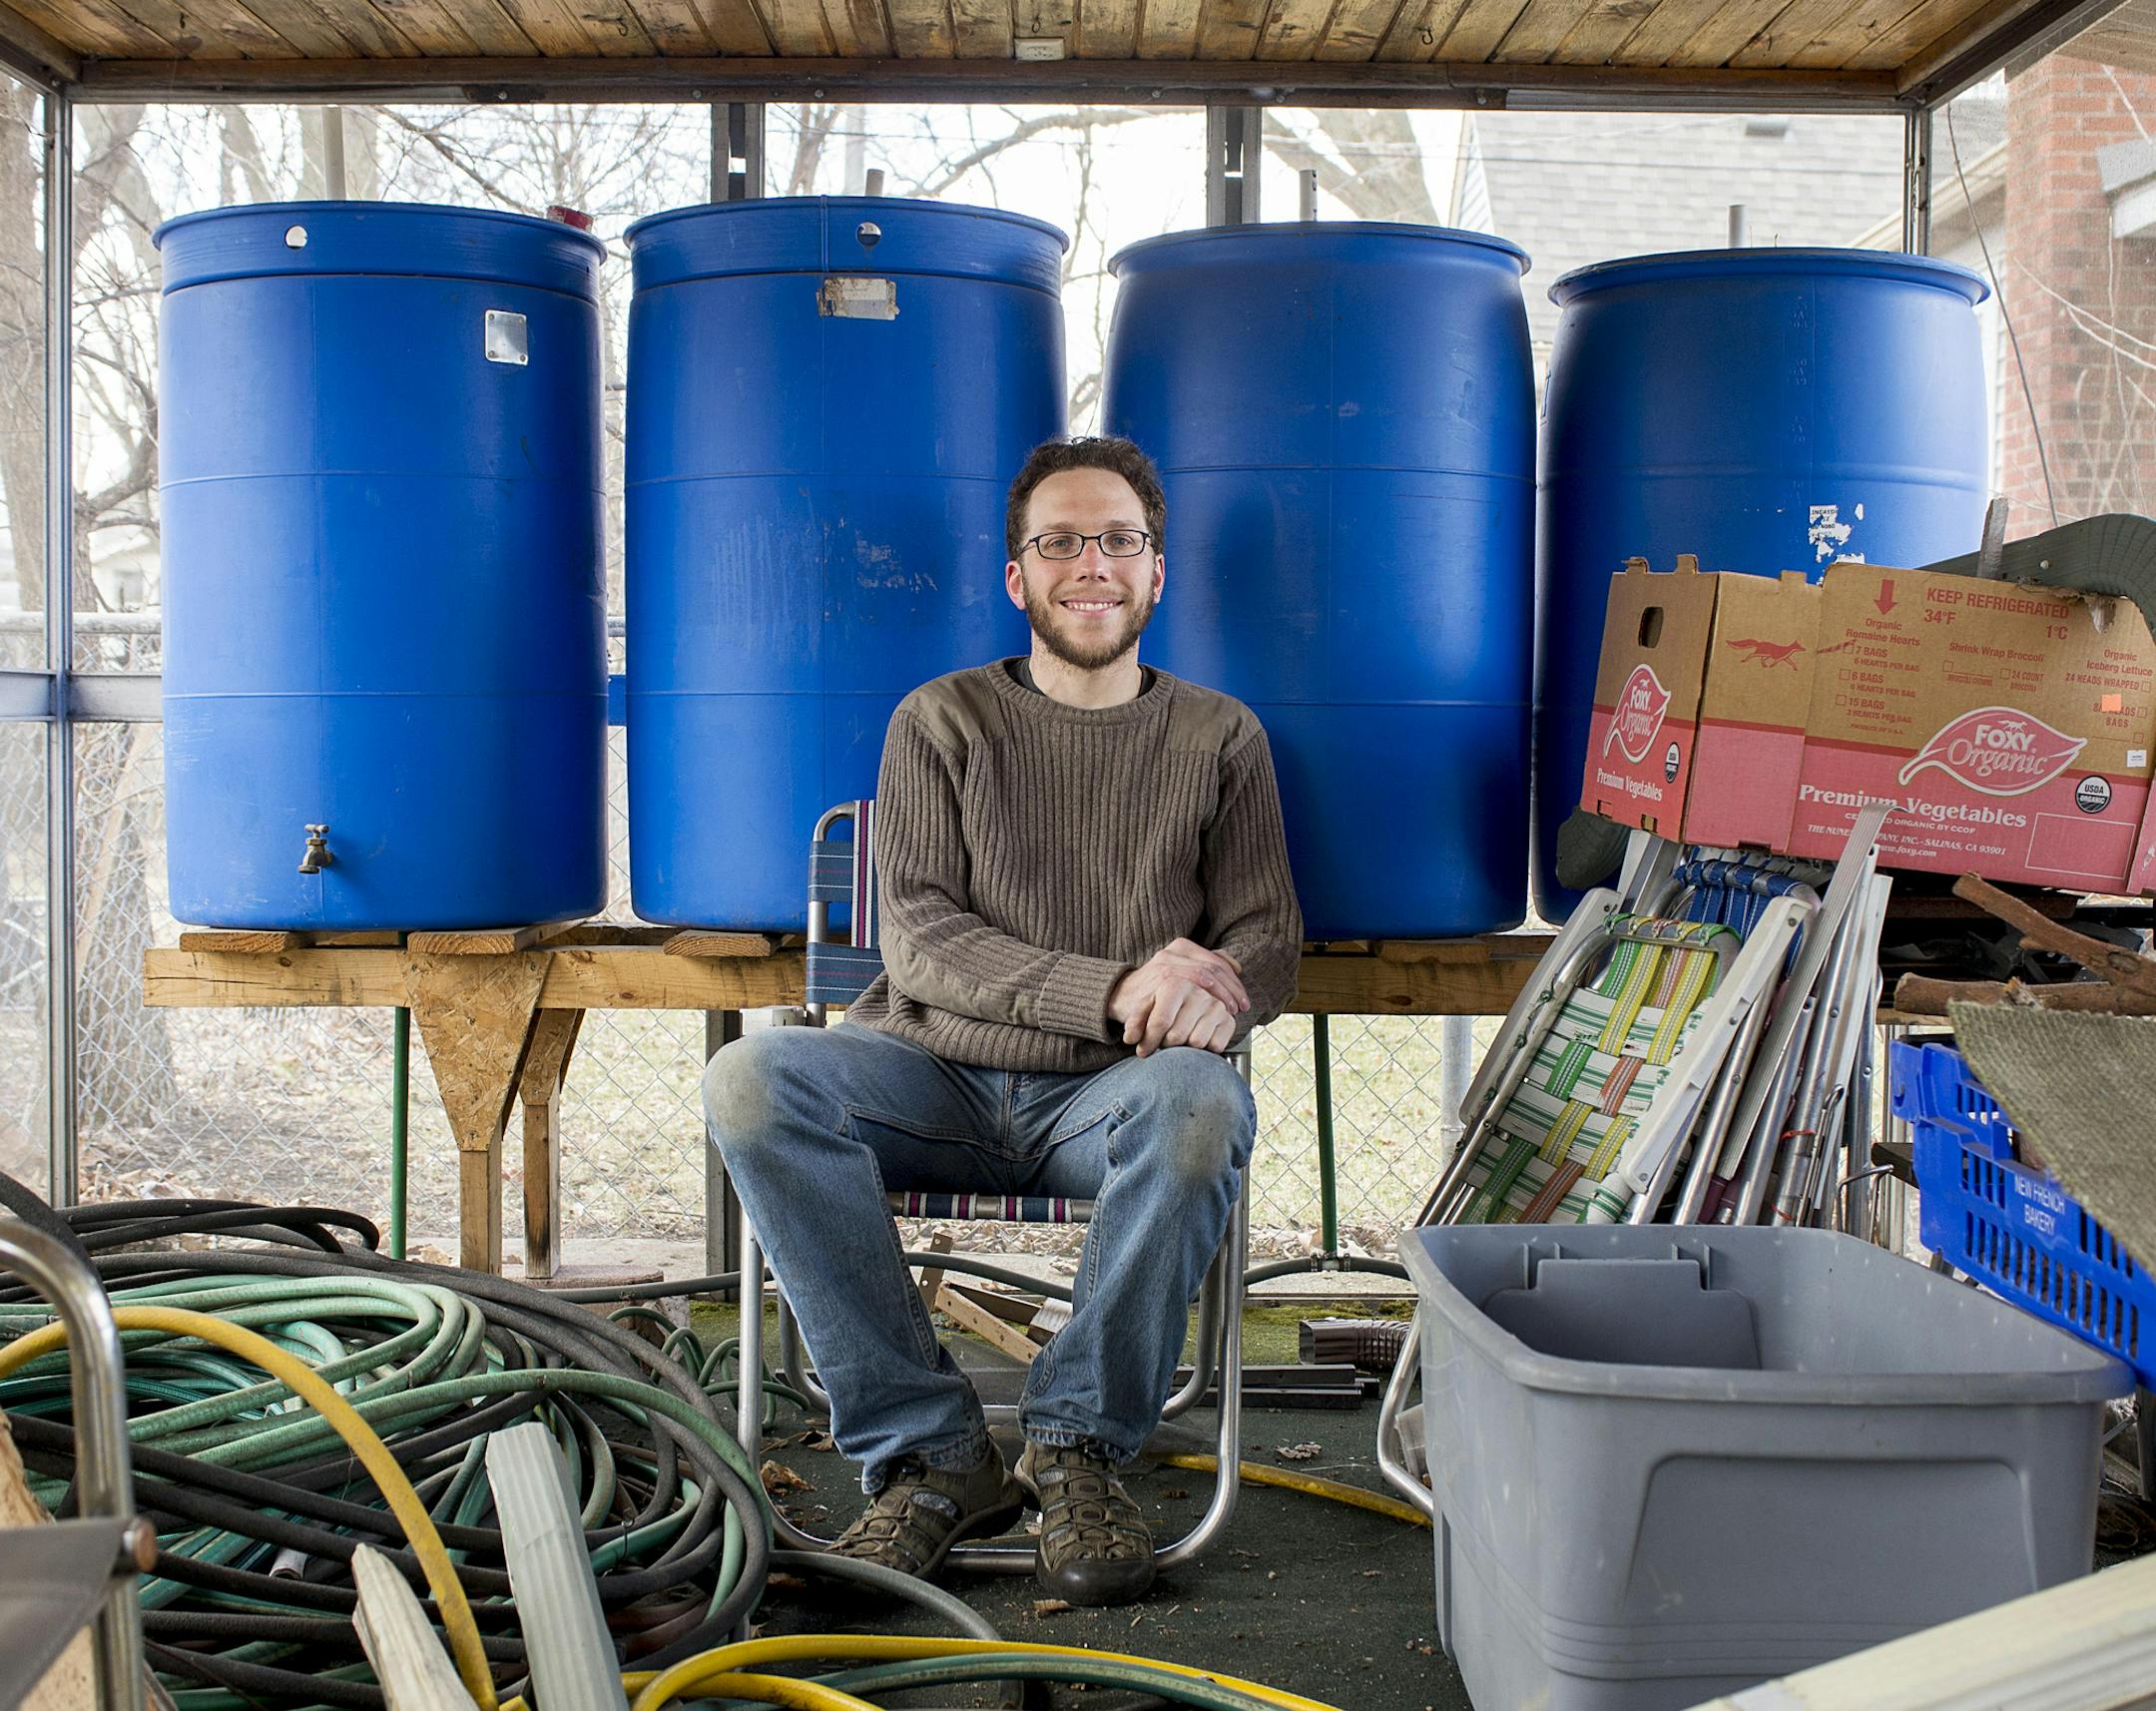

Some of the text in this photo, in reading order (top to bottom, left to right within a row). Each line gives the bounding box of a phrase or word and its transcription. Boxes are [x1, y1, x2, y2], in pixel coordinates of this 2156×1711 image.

[1926, 587, 2069, 619] KEEP REFRIGERATED
[1865, 618, 1902, 630] Organic
[1847, 629, 1920, 646] Romaine Hearts
[1864, 647, 1888, 658] BAGS
[1948, 642, 2044, 663] Shrink Wrap Broccoli
[2104, 649, 2138, 661] Organic
[1861, 659, 1888, 669] HEARTS
[2086, 660, 2153, 677] Iceberg Lettuce
[1860, 672, 1885, 684] BAGS
[2011, 670, 2044, 683] 24 COUNT
[2076, 674, 2102, 686] HEADS
[2104, 678, 2140, 690] WRAPPED
[1857, 685, 1885, 694] HEARTS
[1886, 688, 1899, 697] PER
[1861, 699, 1886, 710] BAGS
[1620, 703, 1654, 743] Organic
[1853, 710, 1881, 720] HEARTS
[2106, 717, 2130, 728] BAGS
[1947, 738, 2048, 777] Organic
[1597, 768, 1662, 802] Premium Vegetables
[2084, 784, 2104, 795] USDA
[2079, 795, 2105, 805] ORGANIC
[1905, 798, 2027, 828] Vegetables
[1894, 818, 1934, 830] ORGANIC
[1950, 826, 1976, 835] CCOF
[1808, 824, 1826, 835] THE
[1826, 826, 1853, 837] NUNE
[1979, 846, 2006, 856] 93901
[2015, 1174, 2065, 1215] NEW FRENCH
[2024, 1204, 2055, 1236] BAKERY
